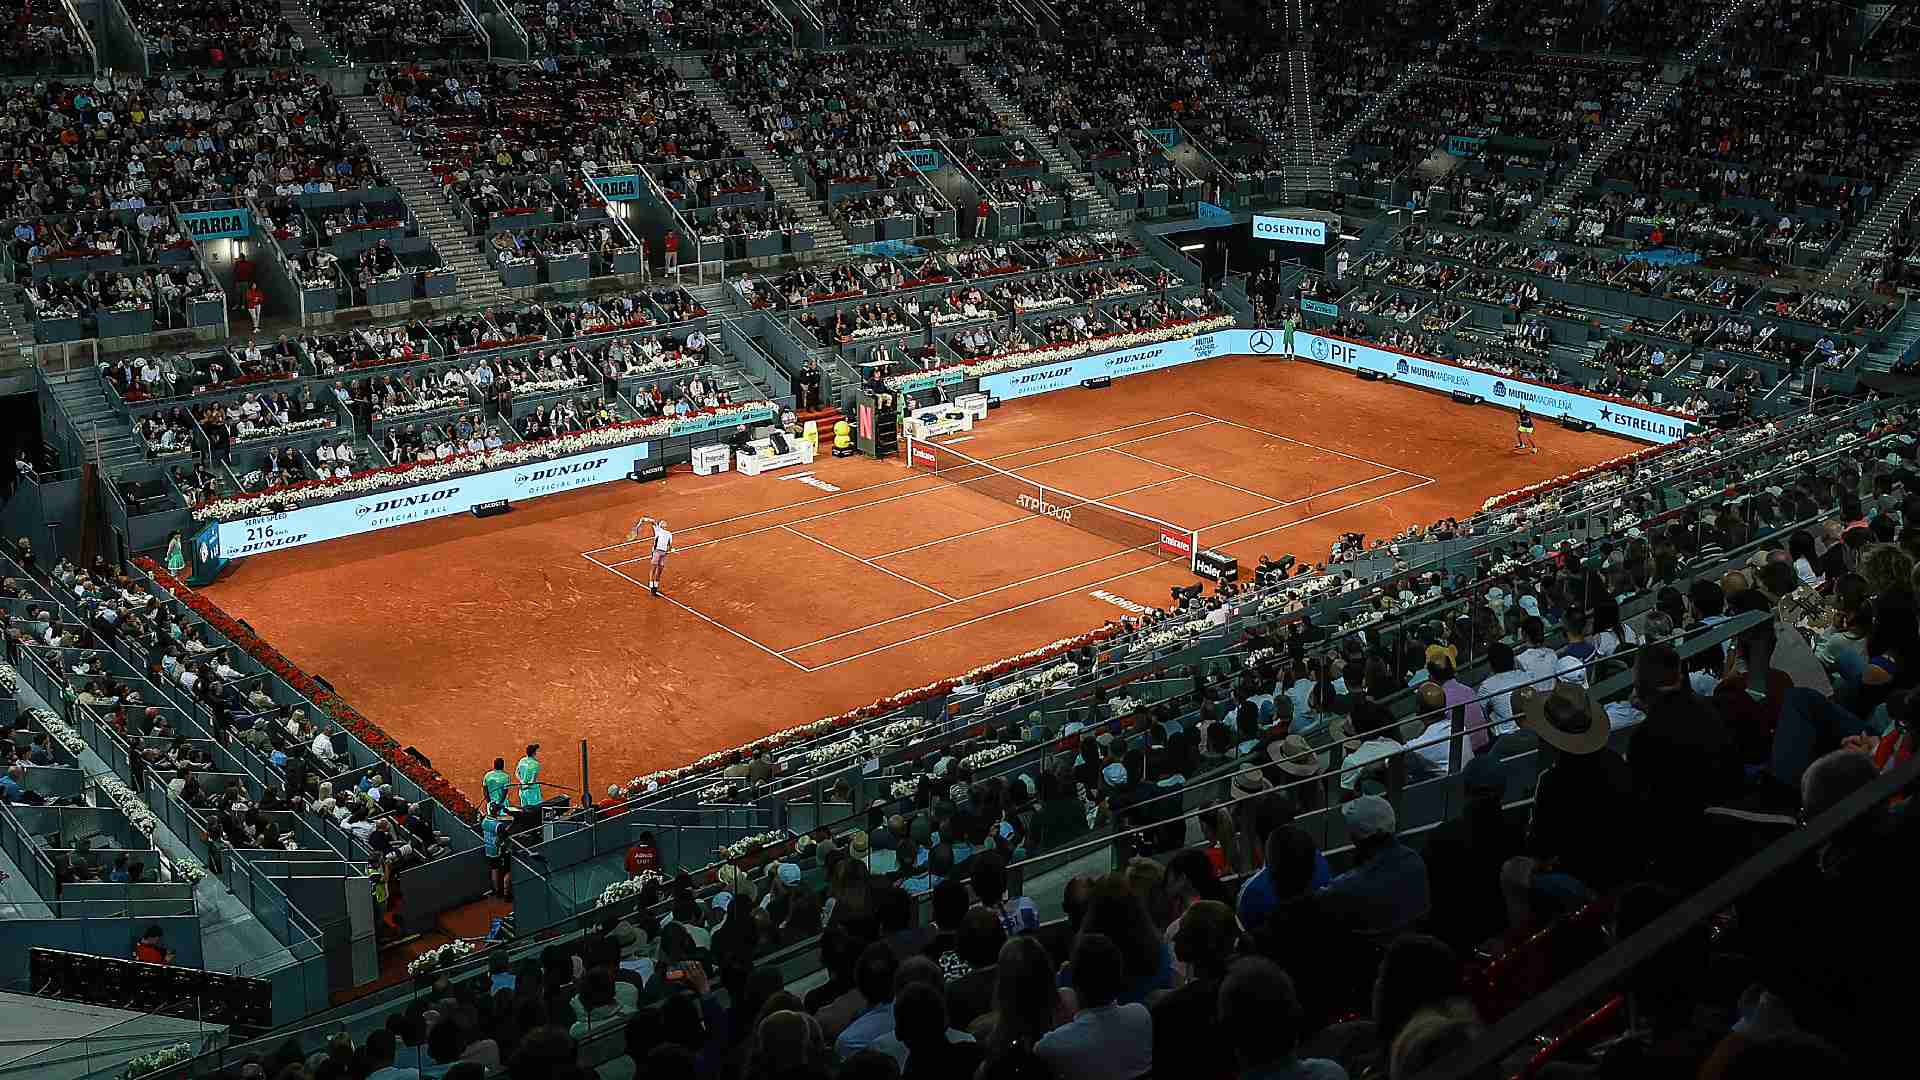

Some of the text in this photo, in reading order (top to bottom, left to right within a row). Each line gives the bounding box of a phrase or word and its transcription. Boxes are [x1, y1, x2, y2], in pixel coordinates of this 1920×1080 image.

[1256, 222, 1321, 238] COSENTINO
[1115, 349, 1162, 365] DUNLOP
[1331, 343, 1357, 364] PIF
[1020, 366, 1073, 384] DUNLOP
[1615, 413, 1665, 437] ESTRELLA
[530, 457, 609, 482] DUNLOP
[575, 474, 598, 485] BALL
[373, 487, 460, 513] DUNLOP
[371, 505, 449, 527] OFFICIAL BALL
[247, 525, 274, 541] 216
[1161, 533, 1190, 551] Emirates
[241, 533, 308, 553] DUNLOP
[1196, 560, 1221, 578] Haier
[1088, 590, 1145, 613] MADRID
